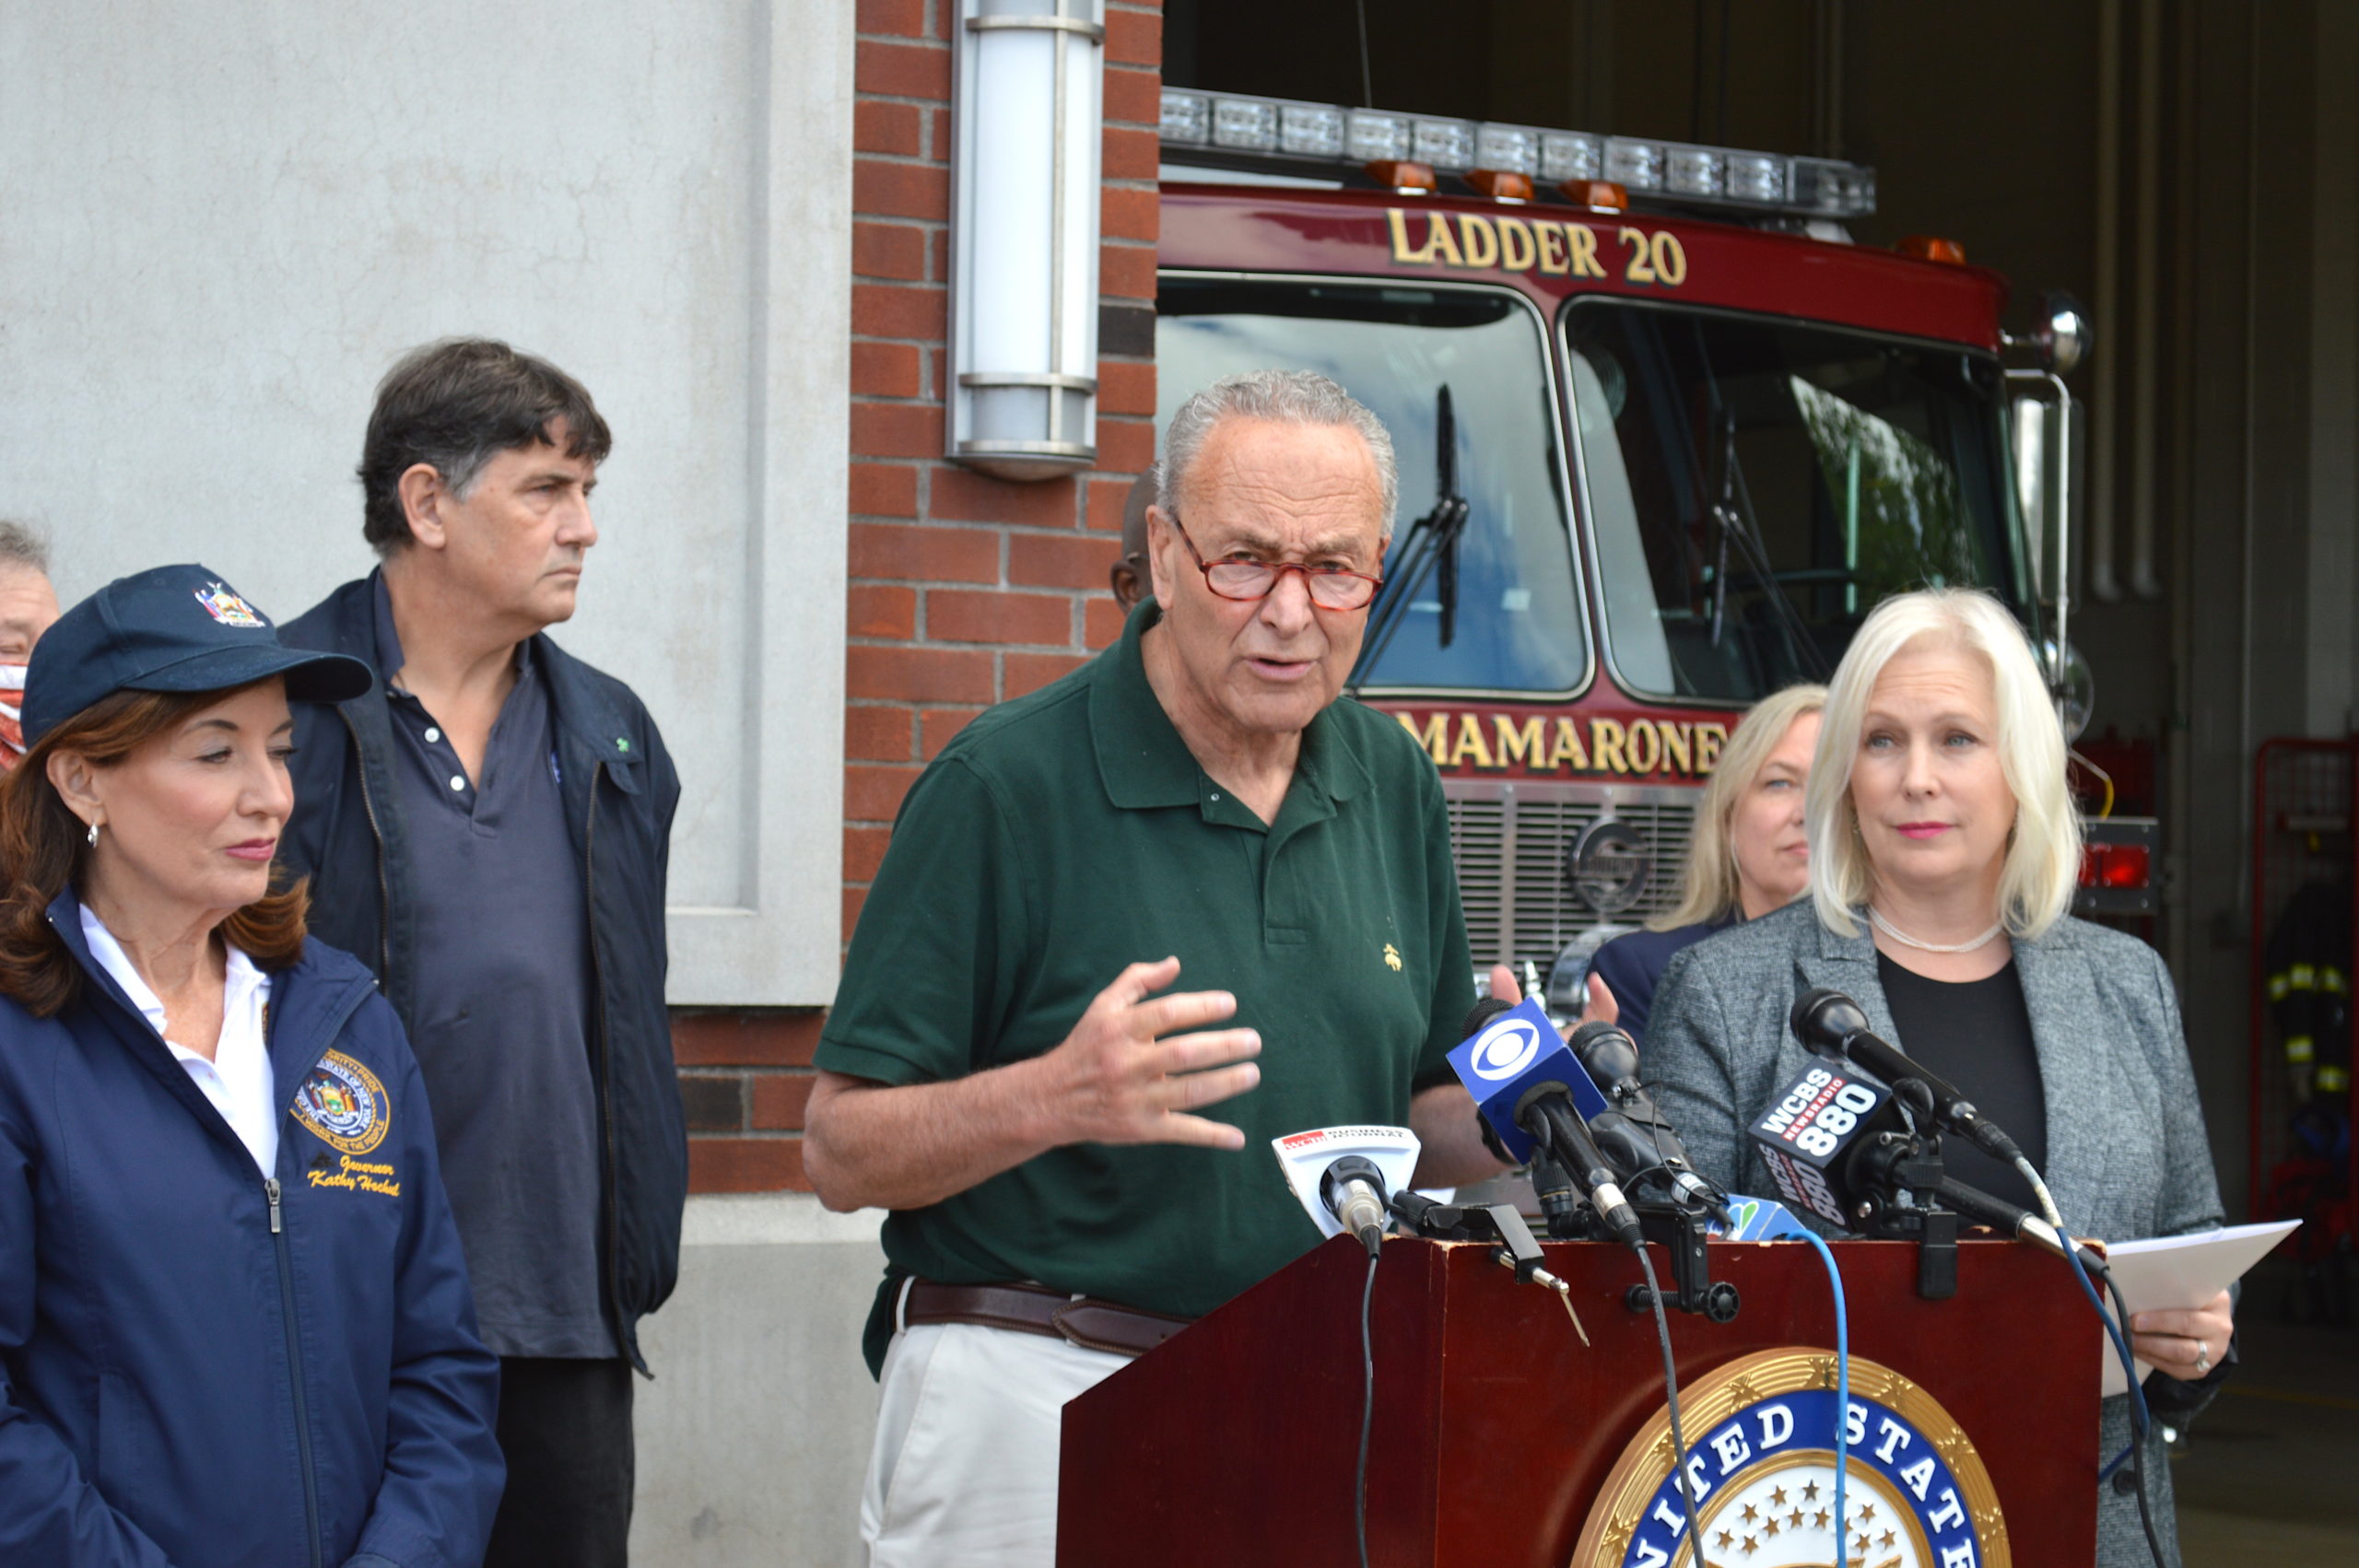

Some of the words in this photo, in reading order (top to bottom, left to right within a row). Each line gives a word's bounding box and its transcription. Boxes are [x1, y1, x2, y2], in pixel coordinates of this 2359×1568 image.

[1386, 208, 1607, 278] LADDER
[1619, 227, 1687, 286] 20
[356, 1068, 380, 1093] PRIDE
[1761, 1068, 1832, 1135] WCBS
[1783, 1078, 1844, 1141] NEWSRADIO
[363, 1117, 385, 1146] PEOPLE
[1796, 1083, 1877, 1157] 880
[307, 1170, 357, 1191] Kathy
[357, 1176, 400, 1197] Hochul
[340, 1154, 394, 1176] Governor
[1759, 1143, 1801, 1202] WCBS
[1791, 1159, 1846, 1226] 880
